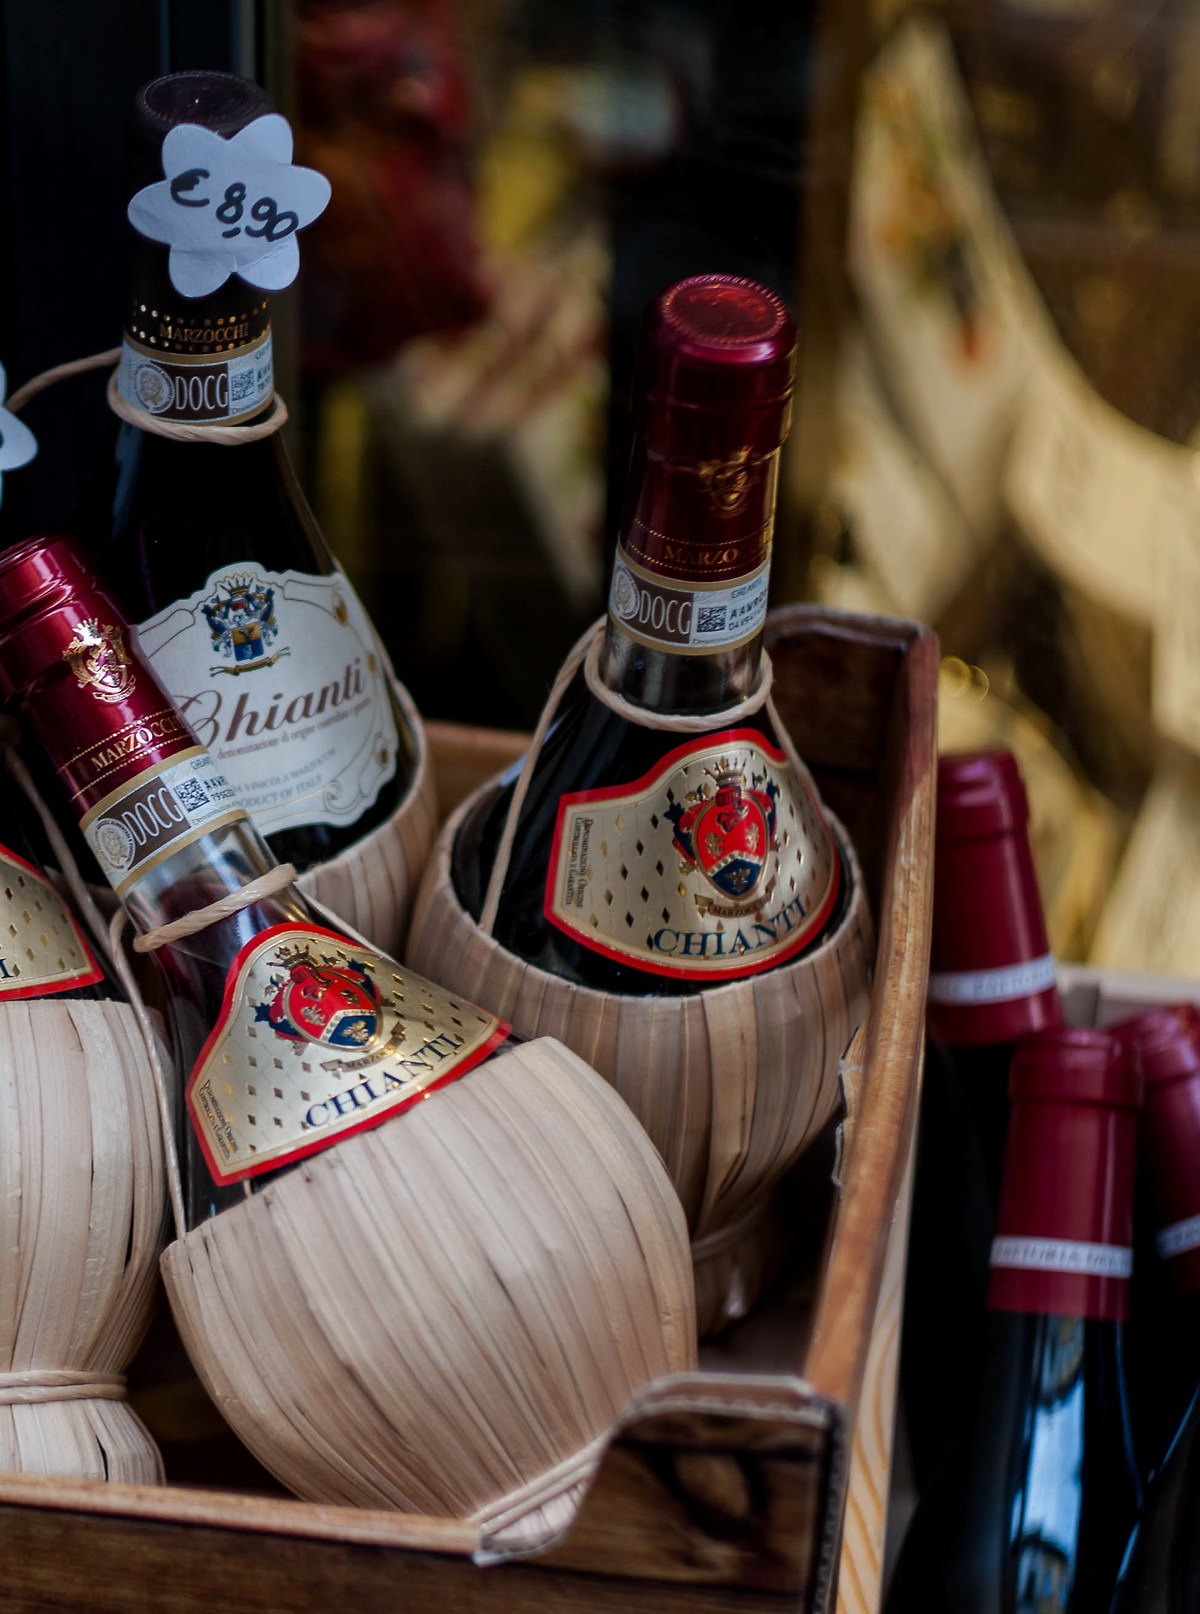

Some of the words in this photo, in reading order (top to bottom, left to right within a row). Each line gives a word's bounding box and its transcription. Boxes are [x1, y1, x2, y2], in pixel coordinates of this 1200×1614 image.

[159, 322, 249, 344] MARZOCCHI
[175, 373, 228, 411] DOCG
[639, 590, 692, 635] DOCG
[90, 715, 186, 772] MARZOCCHI
[121, 787, 184, 846] DOCG
[653, 897, 809, 956] CHIANTI
[305, 1032, 462, 1128] CHIANTI
